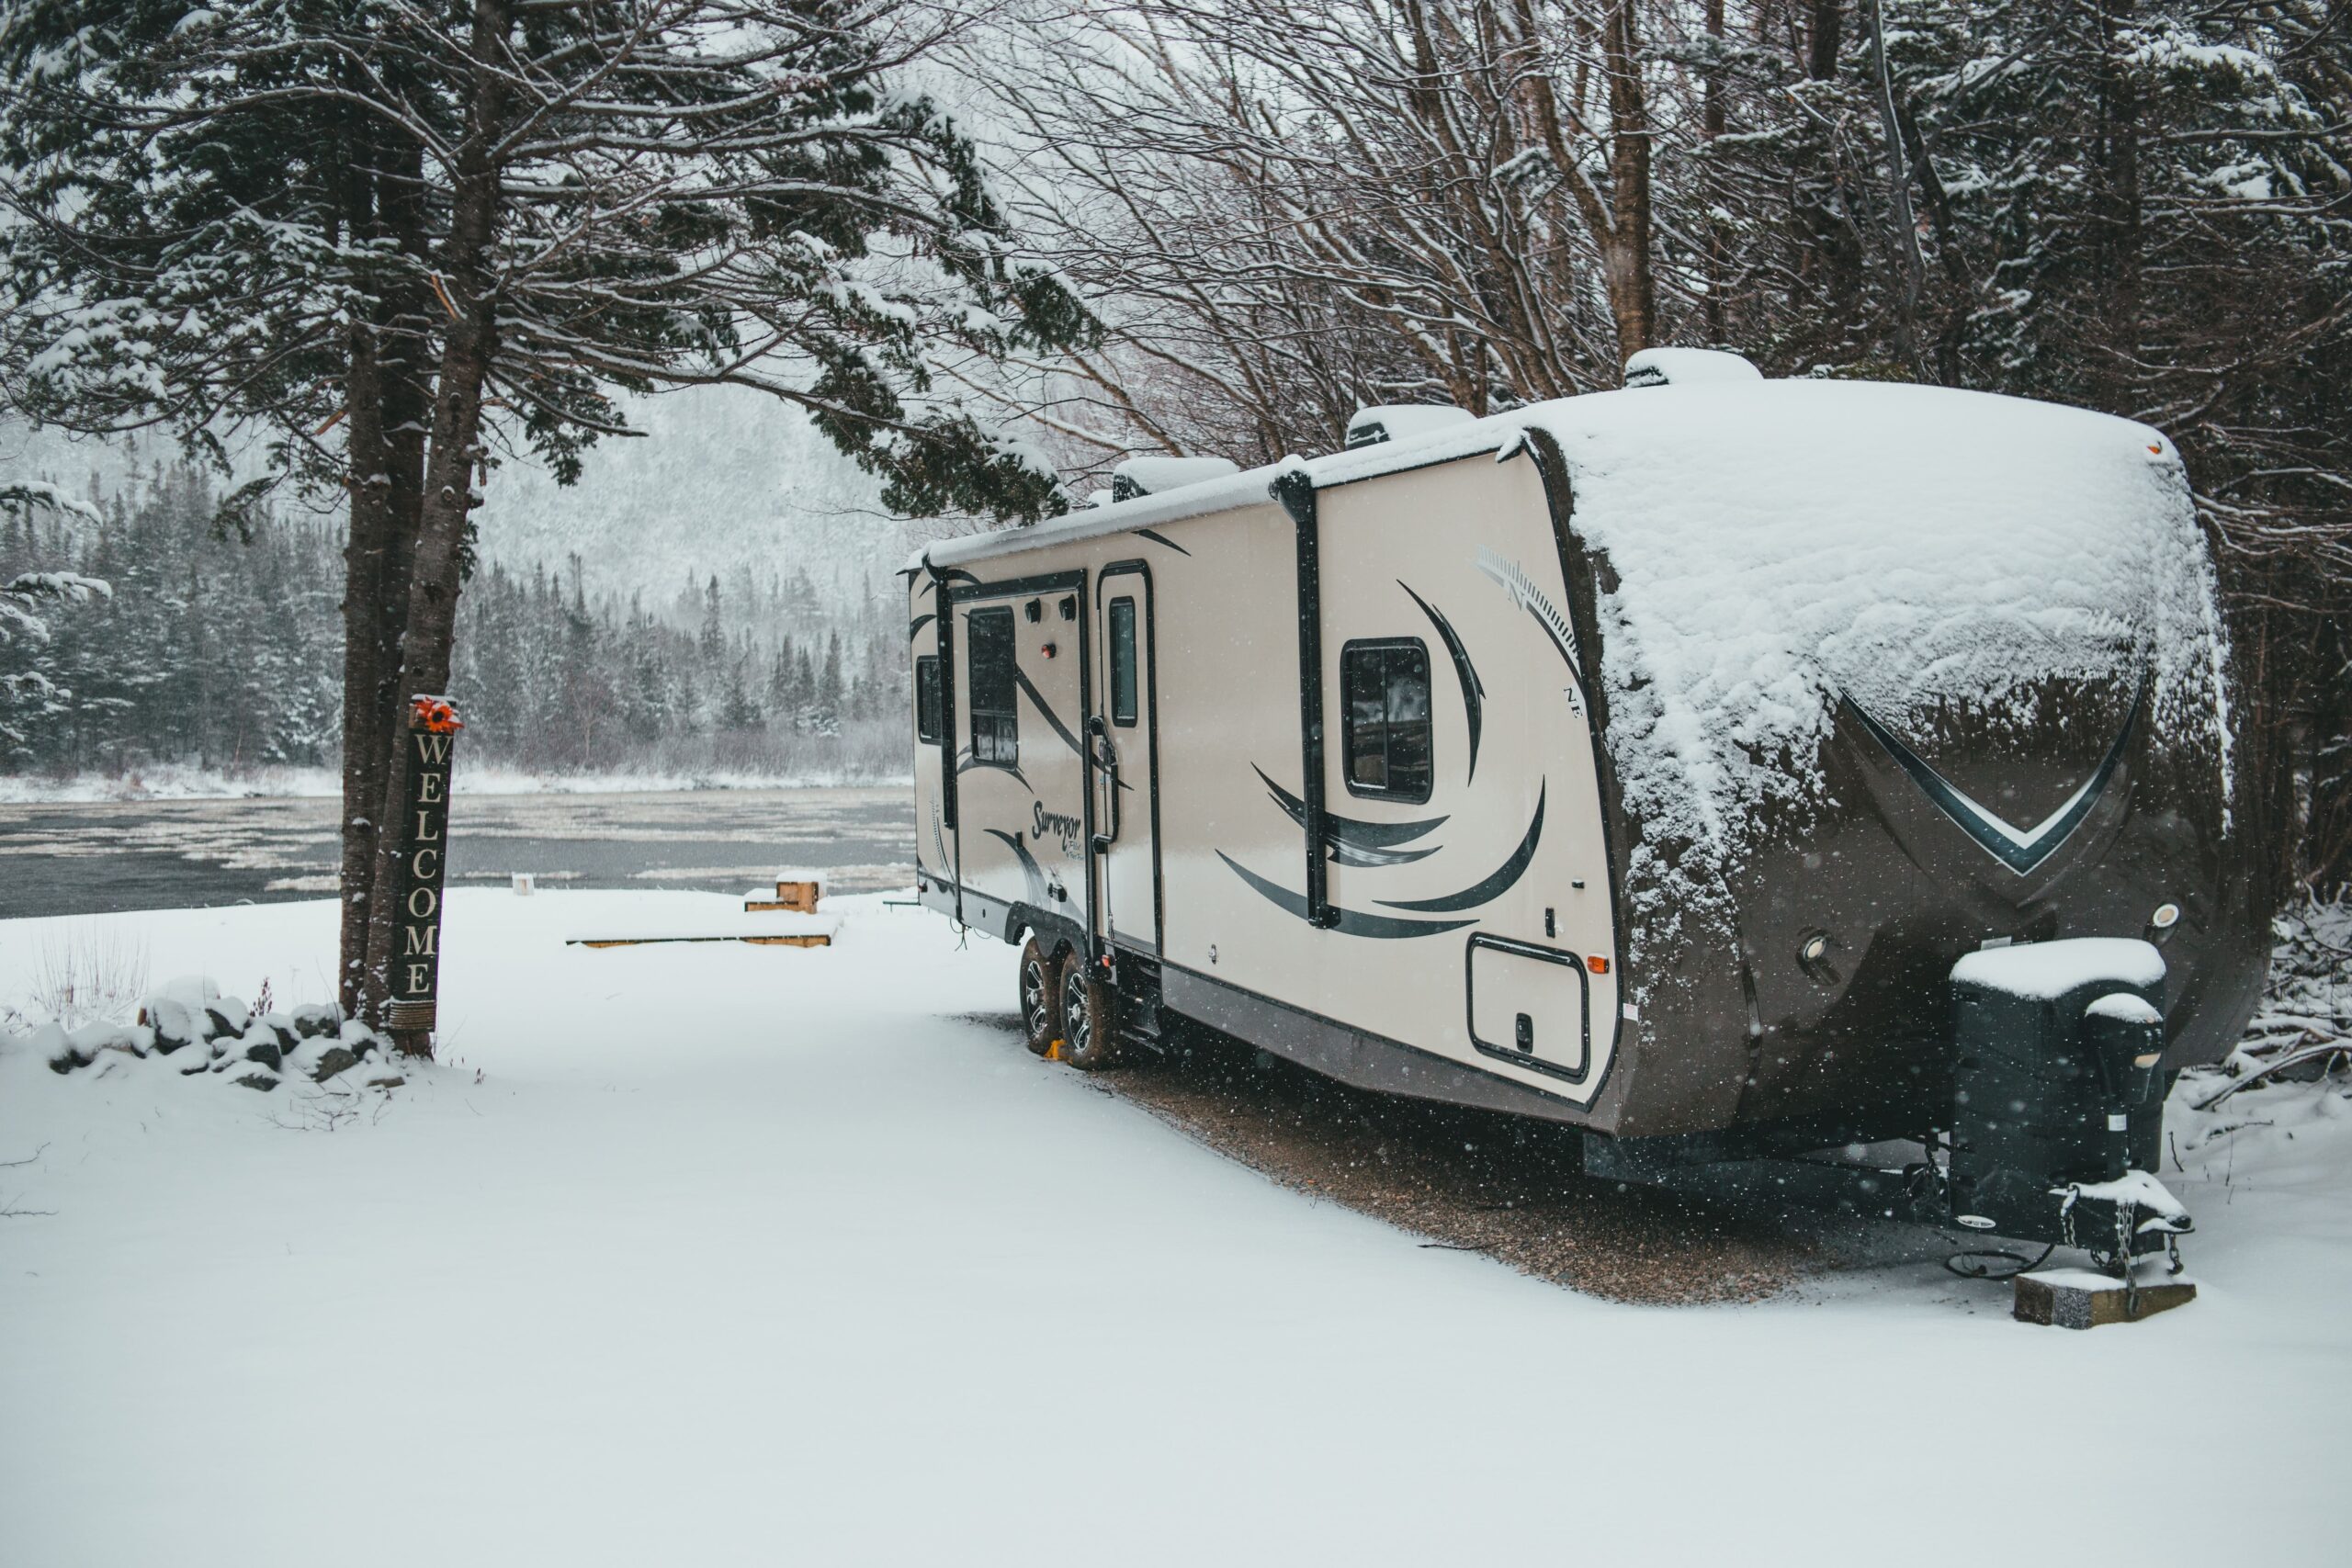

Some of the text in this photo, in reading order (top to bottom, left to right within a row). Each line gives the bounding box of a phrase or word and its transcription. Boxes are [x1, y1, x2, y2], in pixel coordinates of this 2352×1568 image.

[1508, 580, 1525, 612] N
[1564, 687, 1583, 718] NE
[1032, 800, 1081, 852] Surveyor
[404, 734, 454, 994] WELCOME
